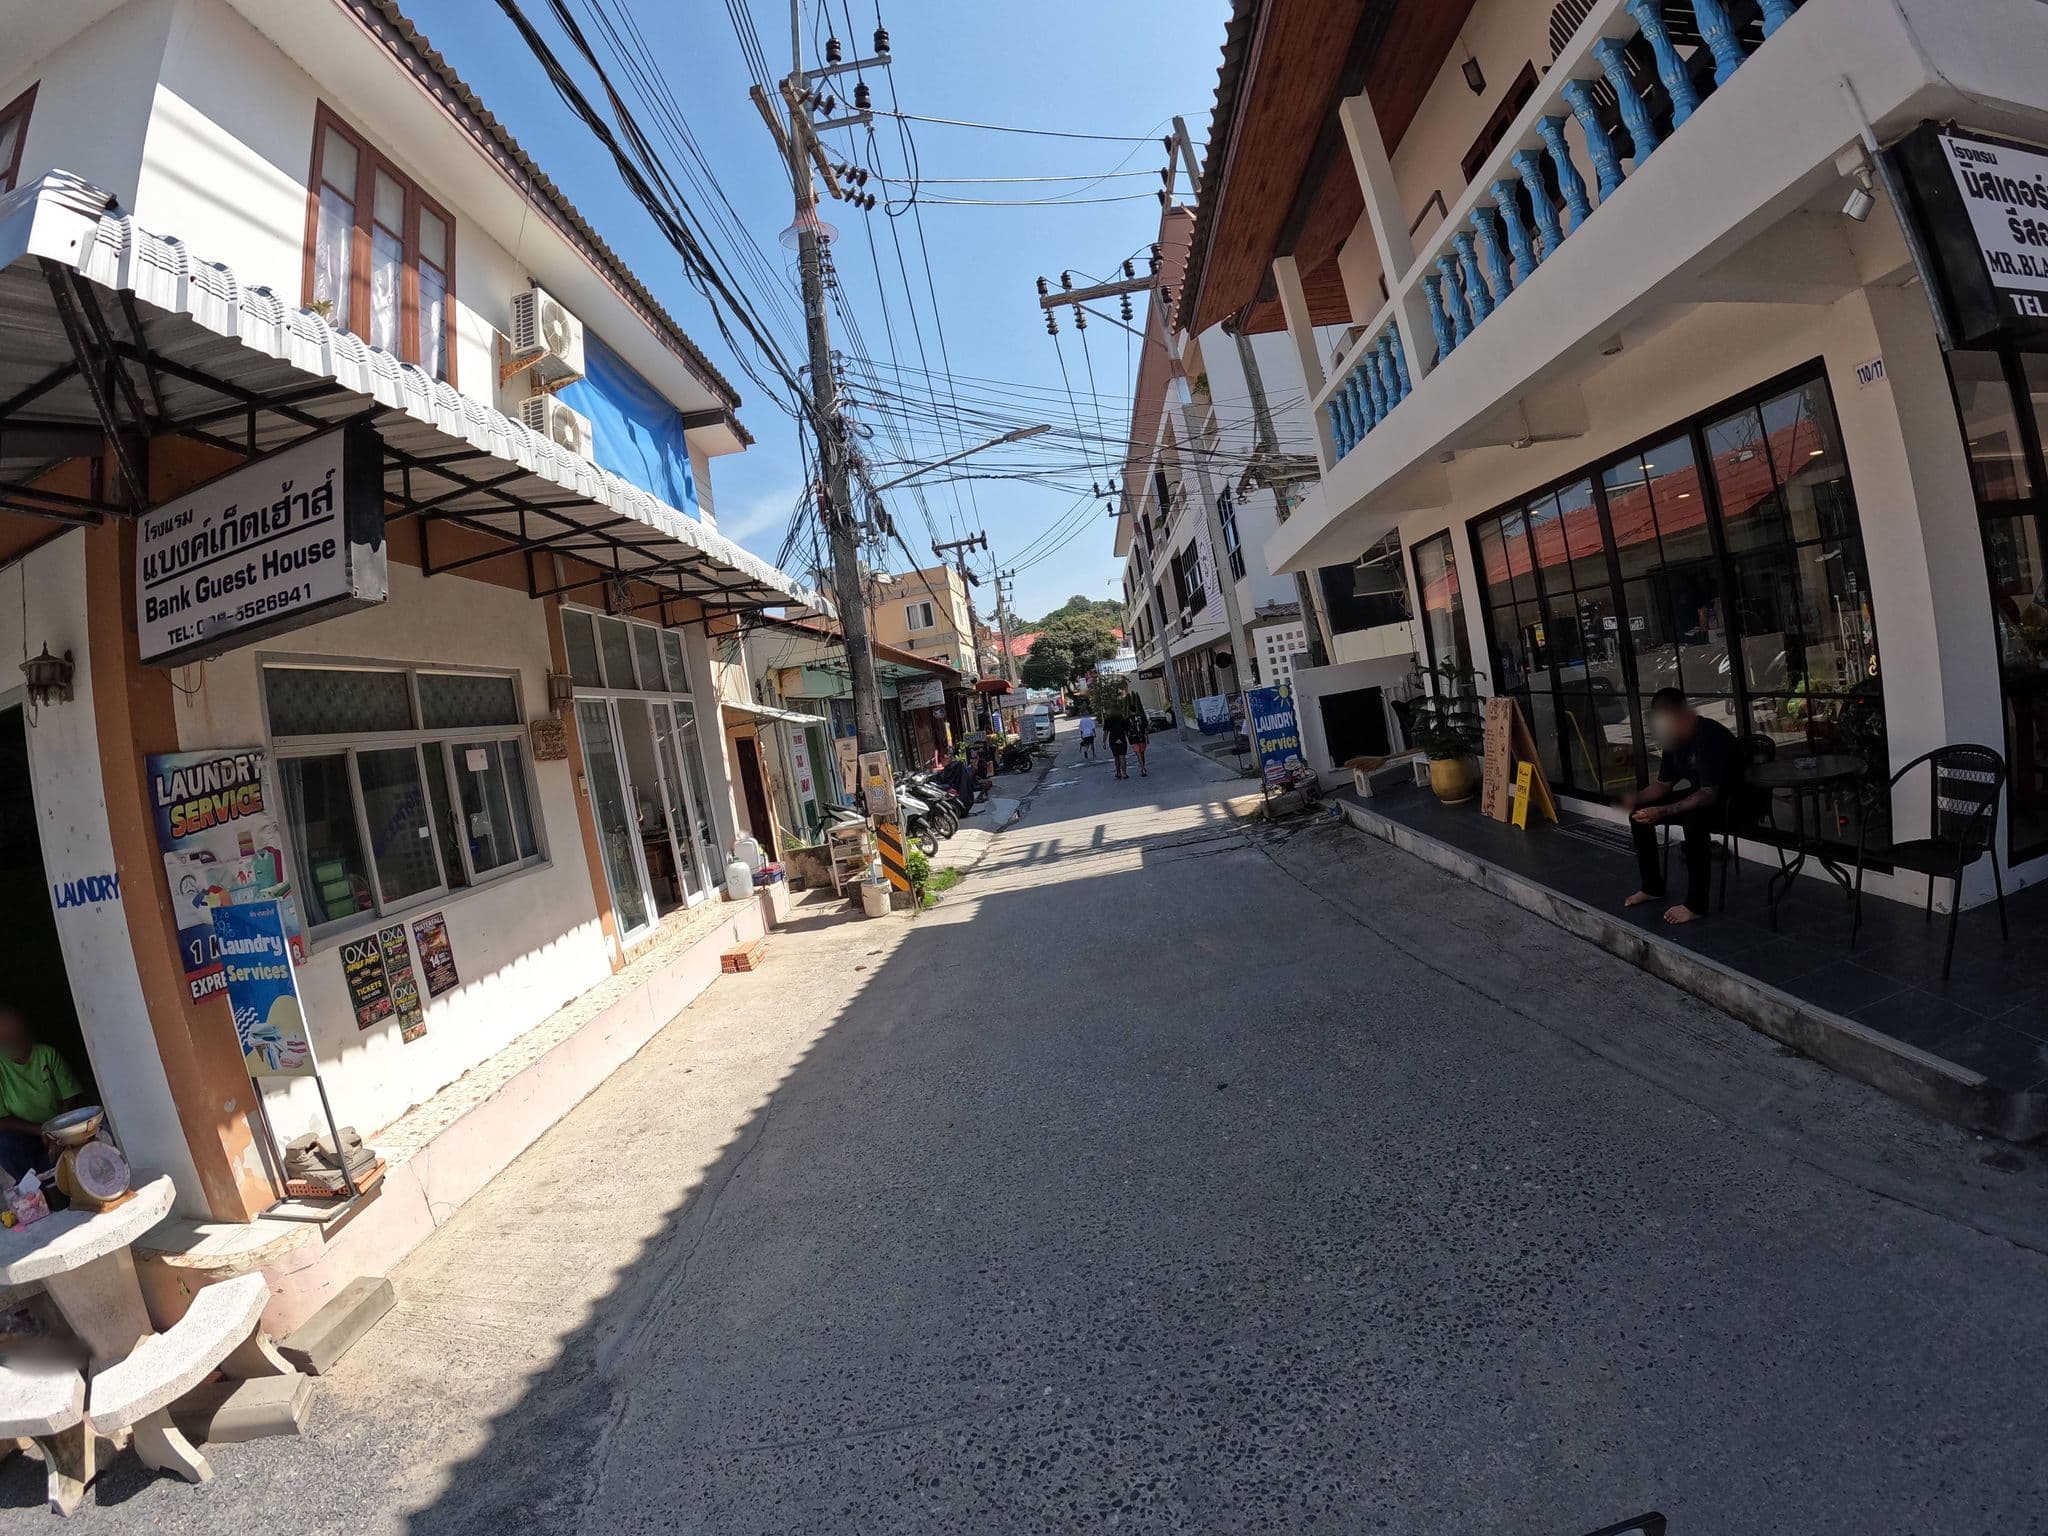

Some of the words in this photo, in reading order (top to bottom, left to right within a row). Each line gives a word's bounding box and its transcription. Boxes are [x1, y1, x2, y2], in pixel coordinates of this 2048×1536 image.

[1947, 139, 1998, 165] โรงแรม
[143, 468, 336, 582] แบงค์เก็ตเฮ้าส์
[143, 508, 193, 543] โรงแรม
[145, 585, 192, 623] Bank
[195, 562, 257, 604] Guest
[262, 538, 336, 581] House
[167, 623, 195, 646] TEL:
[1255, 711, 1295, 733] LAUNDRY
[1259, 733, 1298, 753] Service
[156, 752, 266, 807] LAUNDRY
[170, 783, 264, 838] SERVICE
[54, 872, 120, 909] LAUNDRY
[190, 939, 203, 965] 1
[218, 934, 283, 957] Laundry
[226, 961, 288, 982] Services
[356, 980, 383, 997] TICKETS
